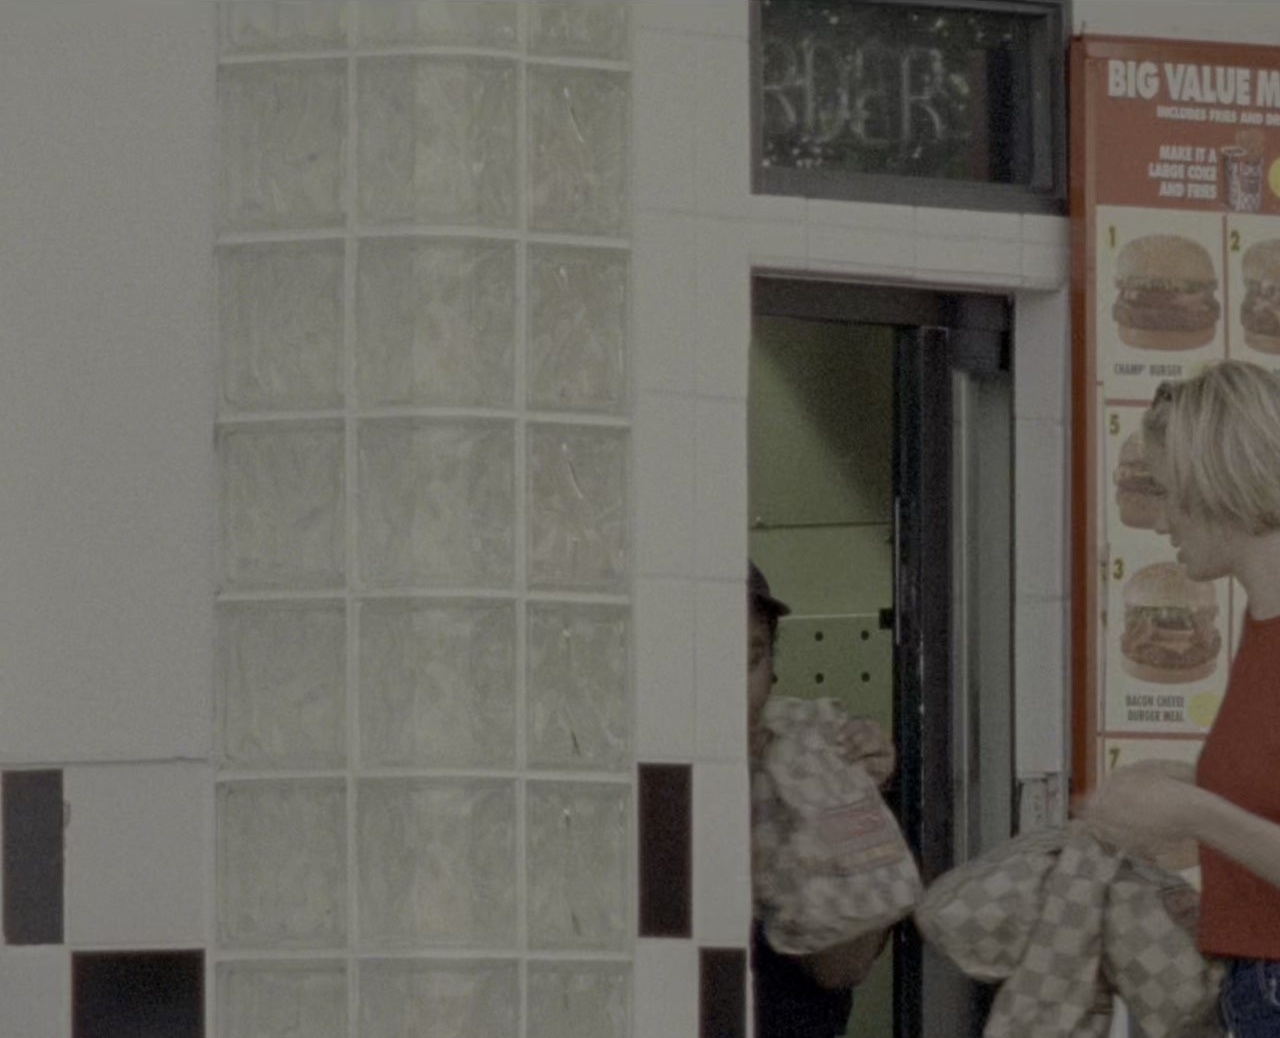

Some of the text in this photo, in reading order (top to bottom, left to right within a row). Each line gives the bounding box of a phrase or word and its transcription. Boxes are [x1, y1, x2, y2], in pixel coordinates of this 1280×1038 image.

[1108, 59, 1160, 100] BIG
[1163, 62, 1251, 106] VALUE
[1156, 105, 1207, 121] INCLUDES
[1209, 109, 1237, 124] FRIES
[1240, 112, 1263, 126] AND
[1158, 145, 1218, 164] MAKE IT A
[1149, 162, 1218, 182] LARGE COKE
[1158, 181, 1218, 200] AND FRIES
[1109, 226, 1118, 248] 1
[1231, 230, 1243, 251] 2
[1149, 365, 1182, 380] BURGER
[1109, 413, 1120, 435] 5
[1112, 557, 1125, 580] 3
[1125, 694, 1185, 709] BACON CHEESE
[1127, 708, 1185, 723] BURGER MEAL
[1109, 747, 1120, 769] 7
